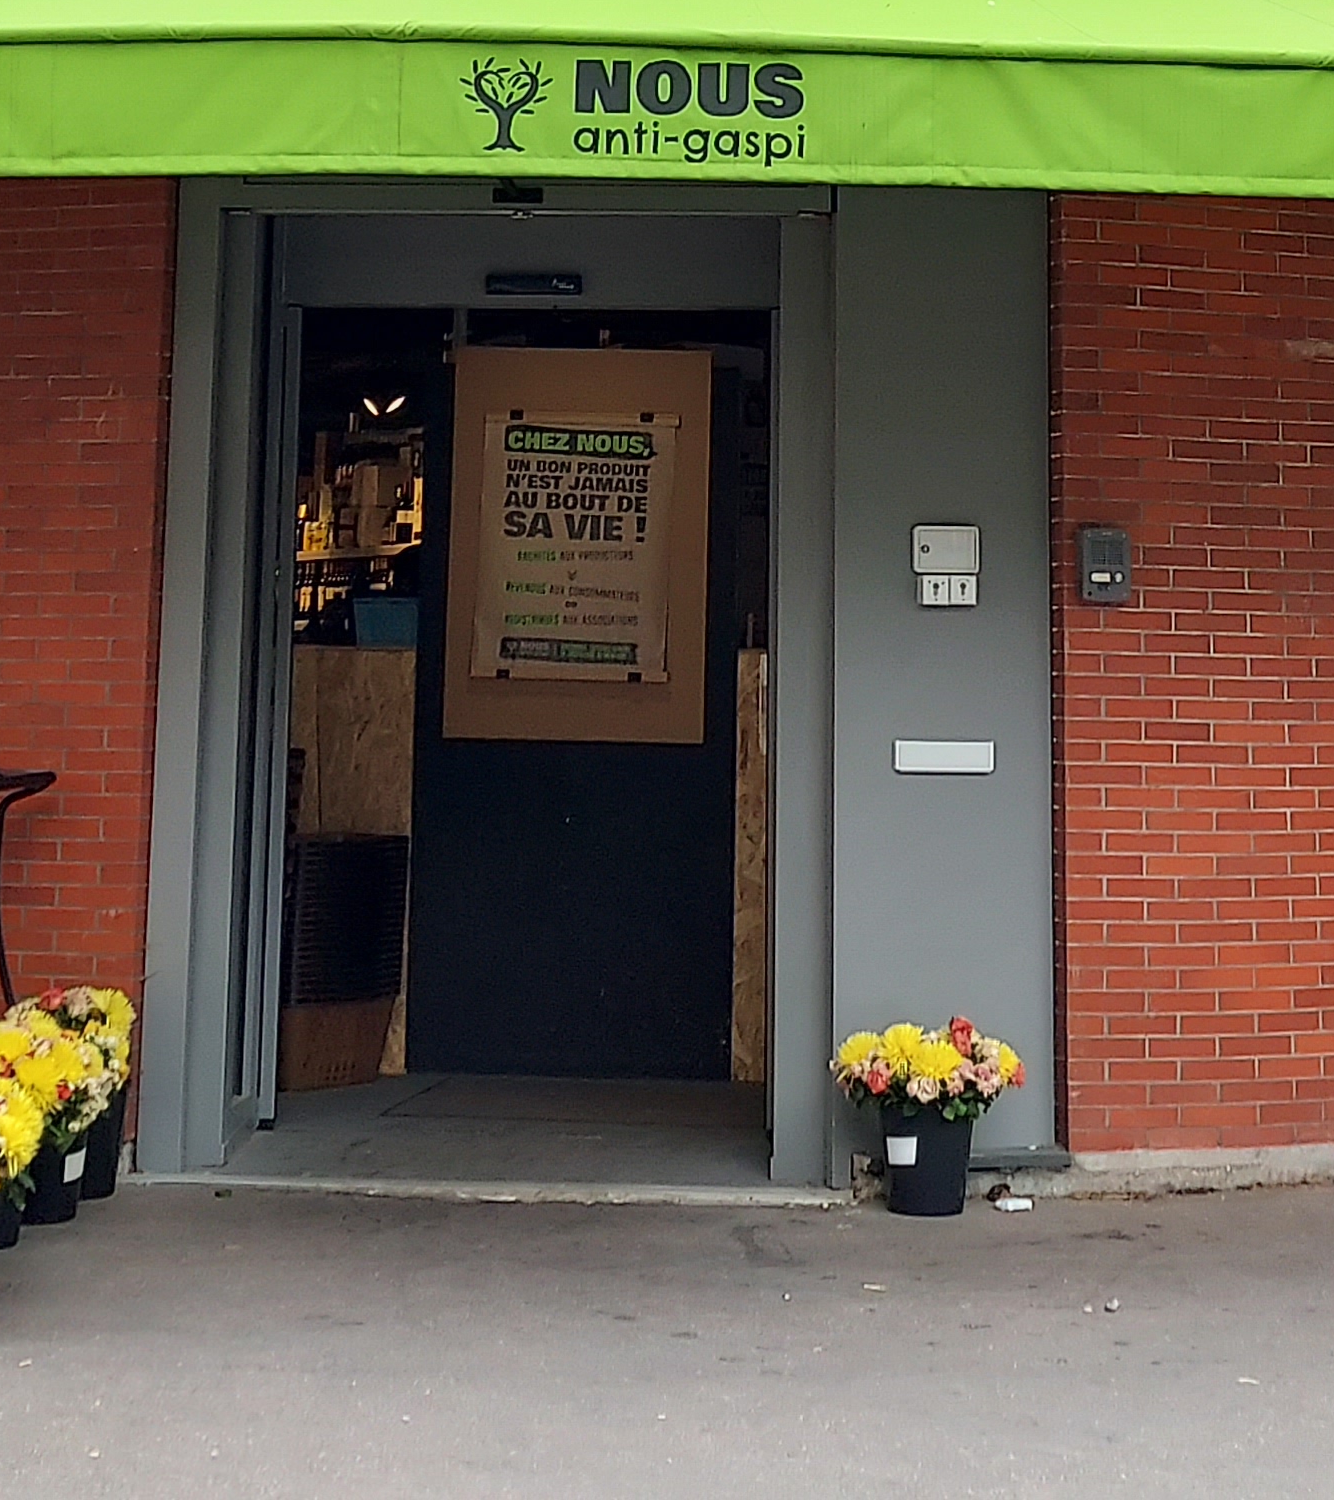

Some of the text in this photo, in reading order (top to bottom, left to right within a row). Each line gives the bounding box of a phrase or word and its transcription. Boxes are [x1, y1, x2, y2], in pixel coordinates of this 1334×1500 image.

[575, 60, 805, 118] NOUS
[574, 120, 805, 166] anti-gaspi
[508, 431, 650, 457] CHEZ NOUS,
[507, 459, 651, 477] UN BON PRODUIT
[505, 473, 648, 493] N'EST JAMAIS
[504, 491, 648, 513] AU BOUT DE
[504, 511, 647, 542] SA VIE !
